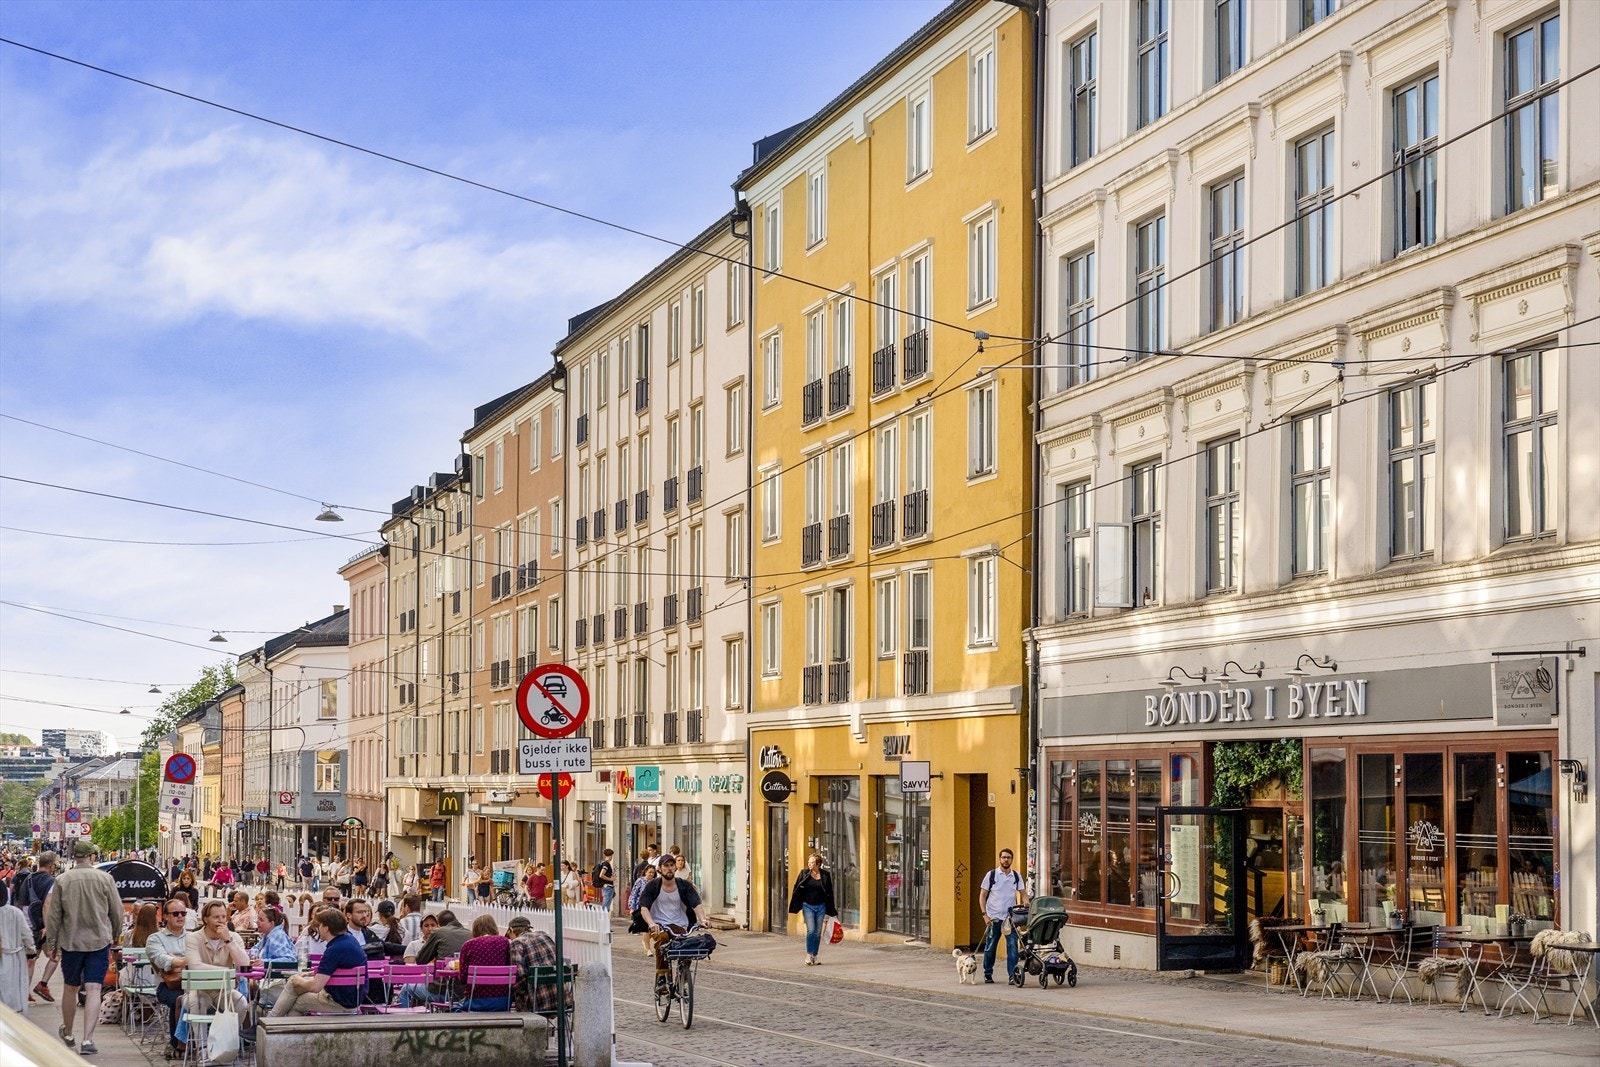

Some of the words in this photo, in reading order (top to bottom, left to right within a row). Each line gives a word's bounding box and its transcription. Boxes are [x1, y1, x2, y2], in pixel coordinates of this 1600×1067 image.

[1144, 688, 1253, 727] BØNDER
[1265, 686, 1278, 720] I
[1287, 679, 1369, 720] BYEN
[522, 744, 561, 757] Gjelder
[566, 744, 588, 753] ikke
[525, 759, 551, 769] buss
[556, 757, 559, 767] i
[563, 758, 586, 767] rute
[540, 779, 570, 787] EXRA
[115, 880, 127, 889] OS
[127, 880, 156, 889] TACOS
